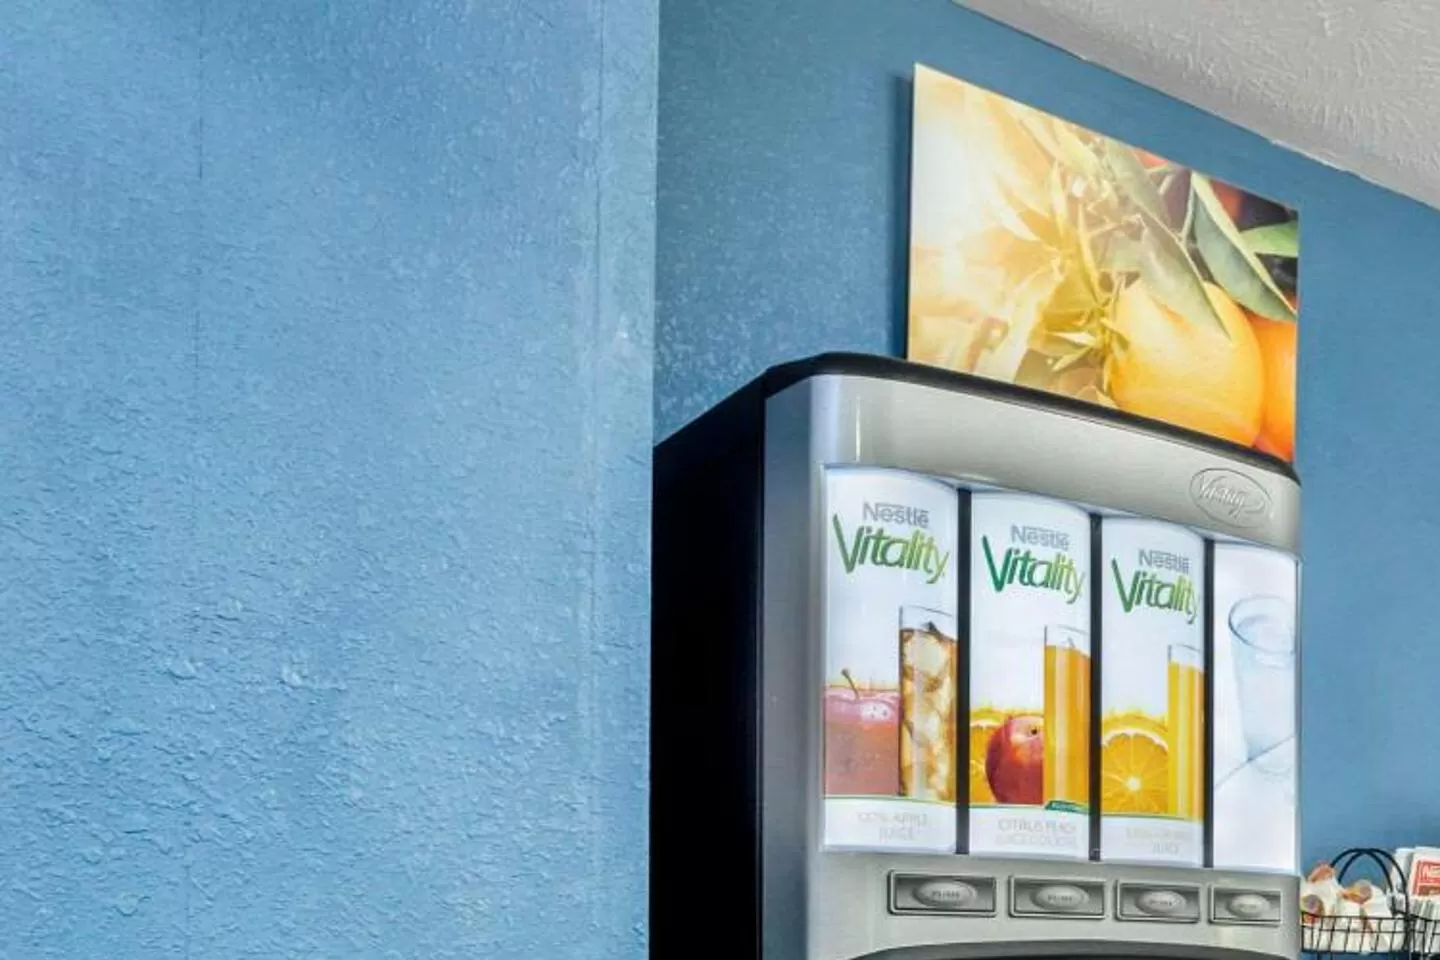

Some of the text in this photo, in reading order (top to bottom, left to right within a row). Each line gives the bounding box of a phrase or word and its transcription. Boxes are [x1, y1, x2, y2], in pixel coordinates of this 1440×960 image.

[832, 512, 950, 585] Vitality
[981, 535, 1087, 605] Vitality
[1111, 557, 1198, 625] Vitality
